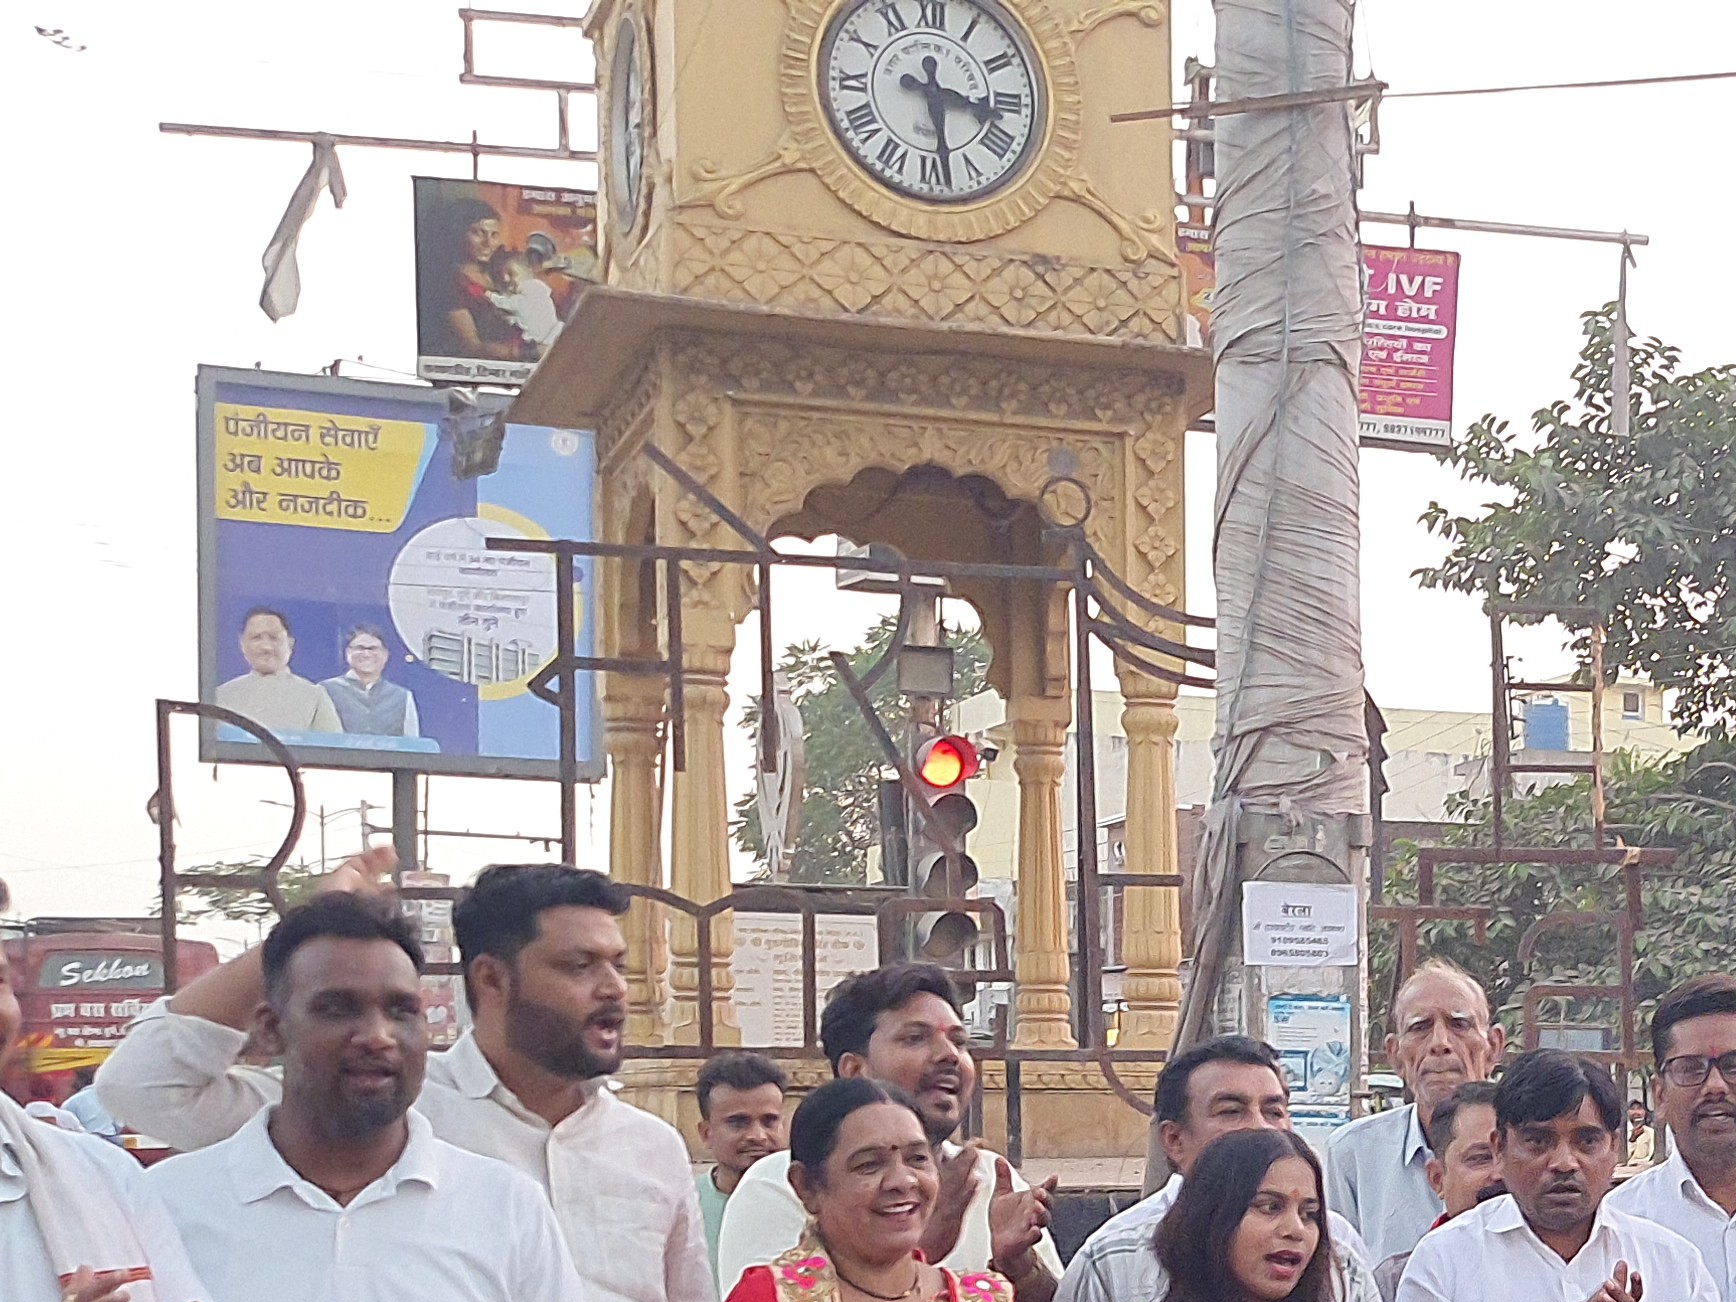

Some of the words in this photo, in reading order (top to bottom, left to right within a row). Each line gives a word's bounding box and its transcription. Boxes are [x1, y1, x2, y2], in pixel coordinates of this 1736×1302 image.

[983, 51, 1014, 74] II
[994, 91, 1022, 114] III
[1388, 273, 1444, 298] IVF
[1395, 299, 1439, 320] होम
[223, 412, 313, 446] पंजीयन
[319, 420, 382, 451] सेवाएँ
[223, 452, 263, 474] अब
[272, 453, 342, 481] आपके
[225, 481, 270, 511] और
